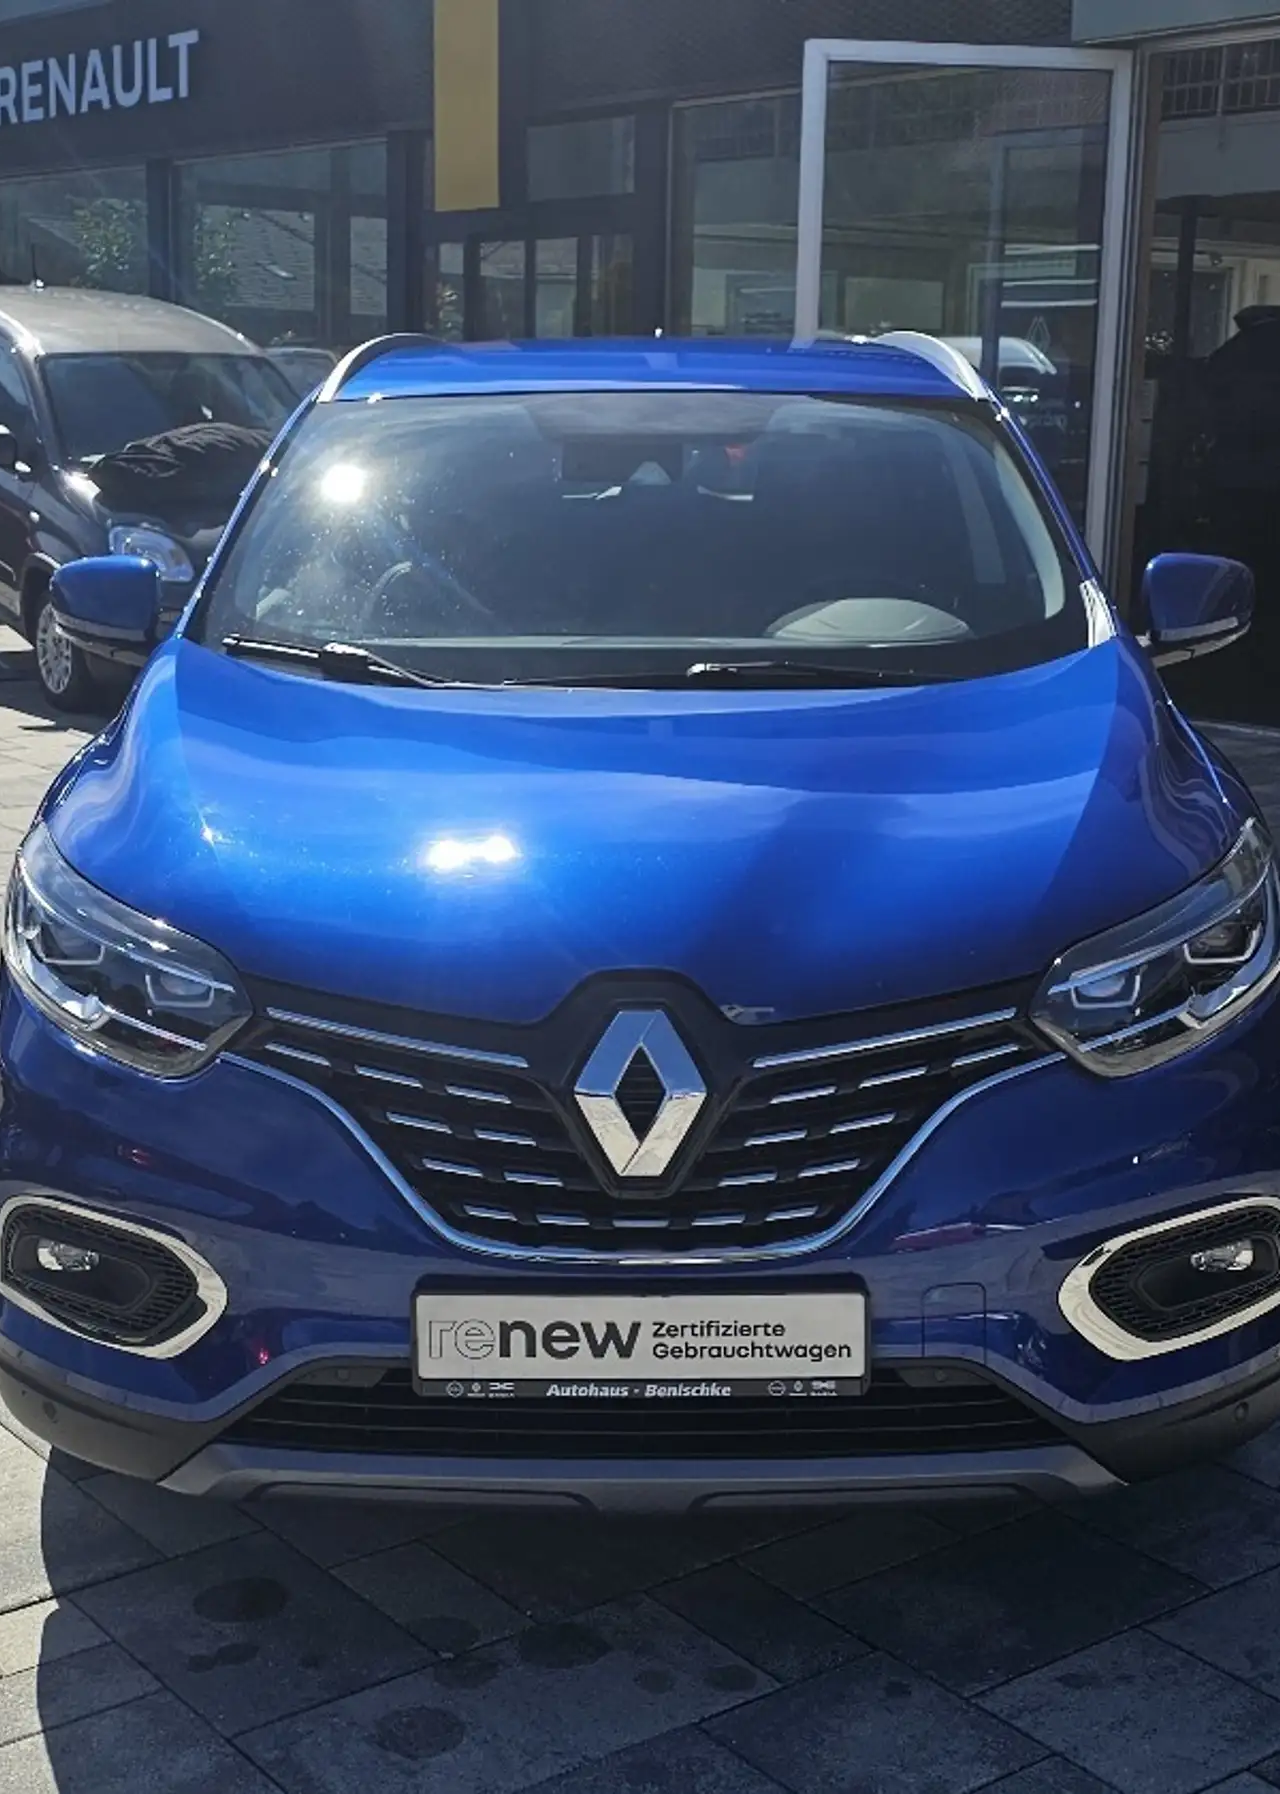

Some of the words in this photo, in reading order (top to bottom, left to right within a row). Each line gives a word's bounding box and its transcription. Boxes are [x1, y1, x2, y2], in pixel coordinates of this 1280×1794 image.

[652, 1320, 786, 1338] Zertifizierte
[428, 1318, 641, 1360] renew
[652, 1341, 852, 1362] Gebrauchtwagen
[546, 1383, 629, 1397] Autohaus
[644, 1382, 731, 1397] Benischke
